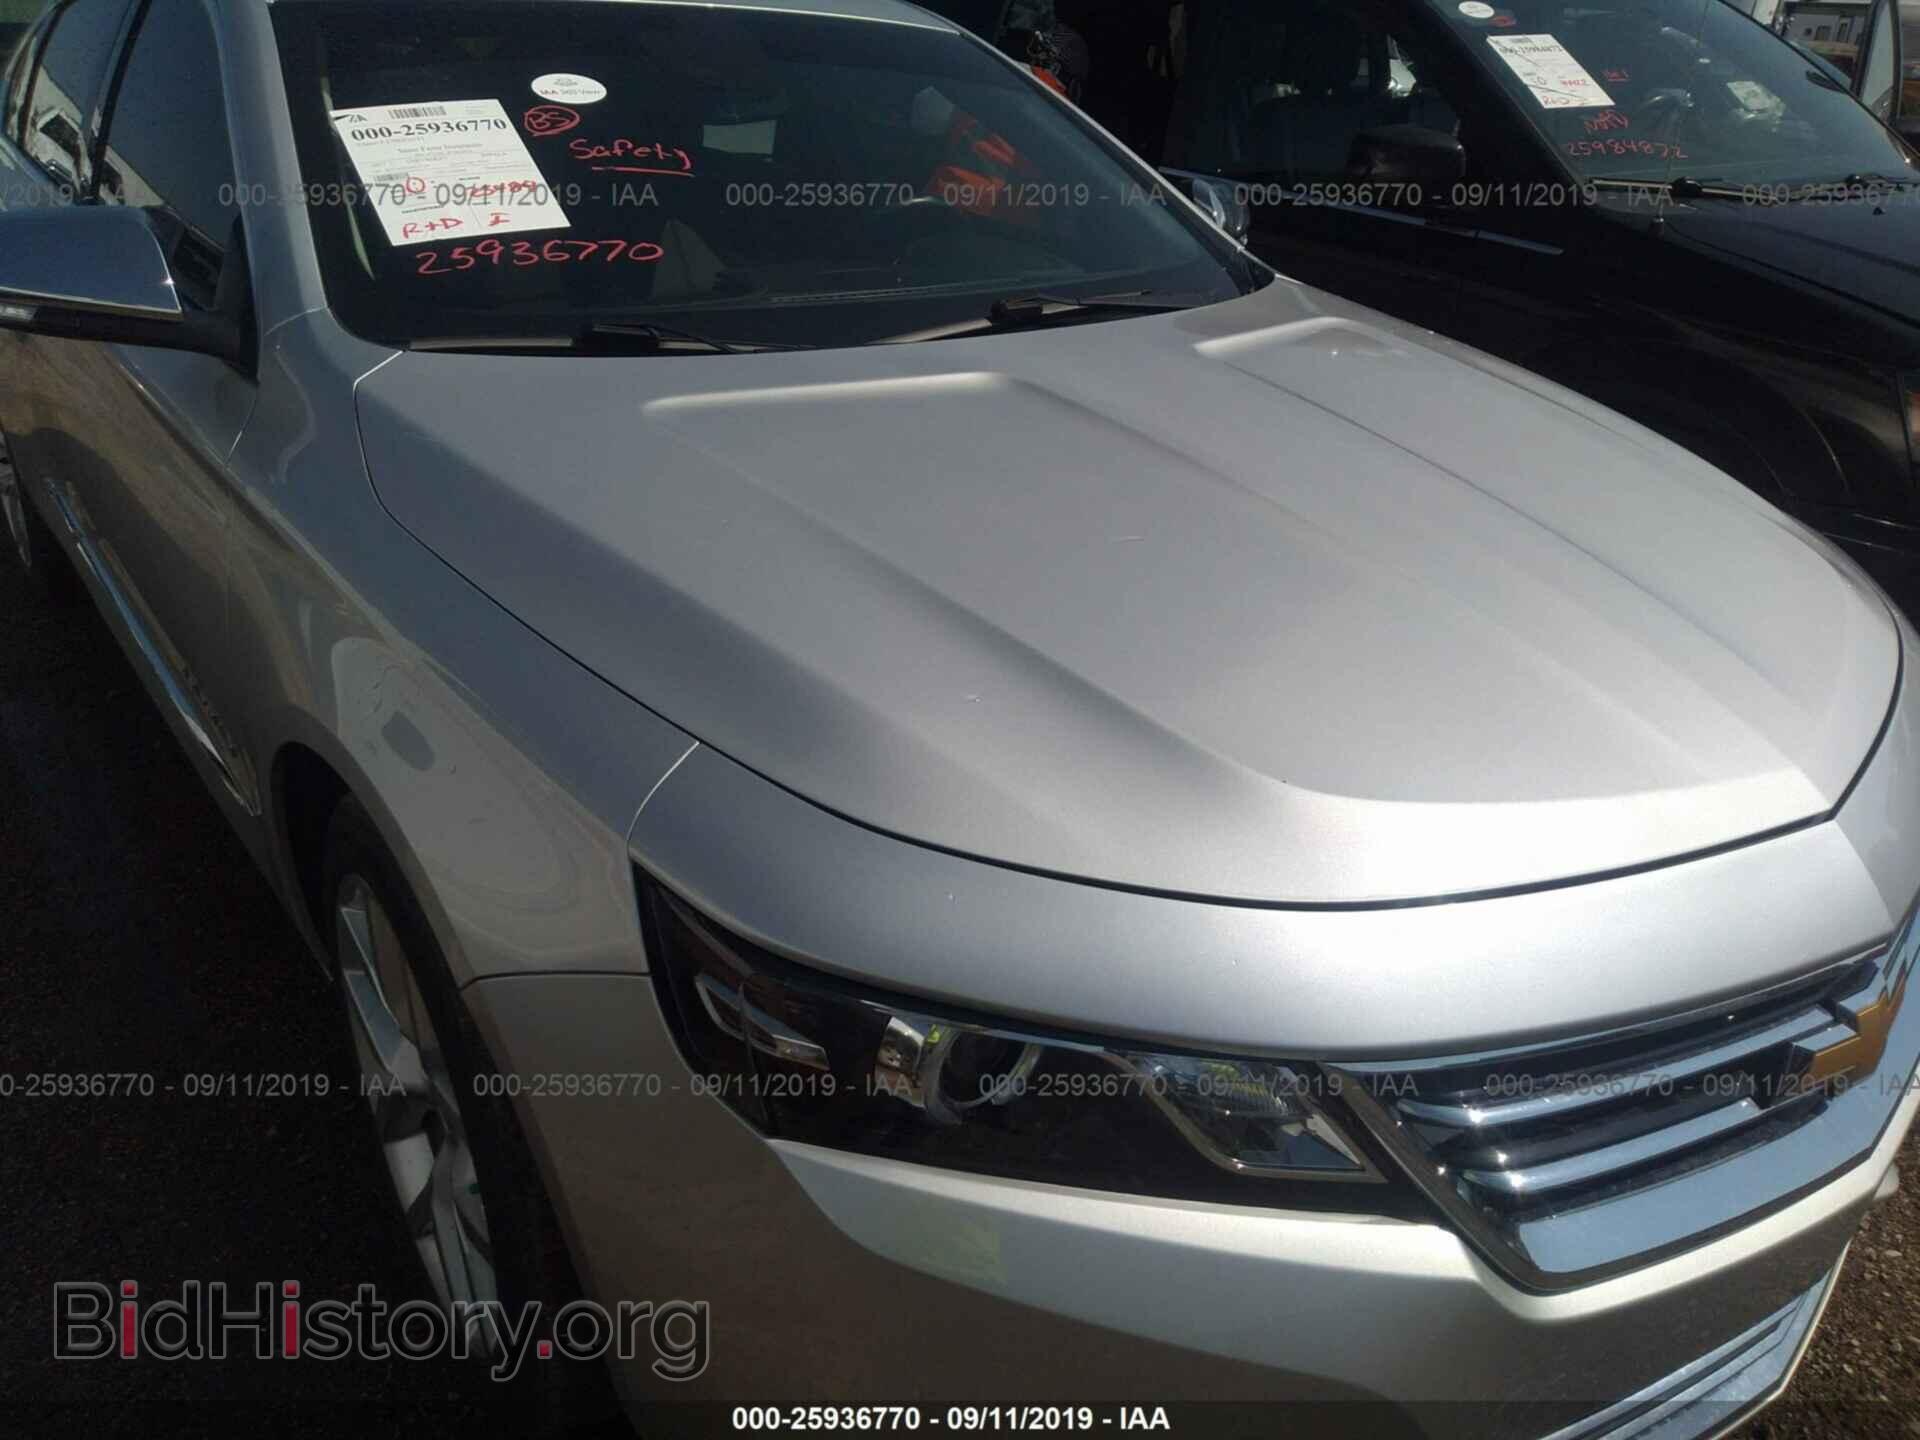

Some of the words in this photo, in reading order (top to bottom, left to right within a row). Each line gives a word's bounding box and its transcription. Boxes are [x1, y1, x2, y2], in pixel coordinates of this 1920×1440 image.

[351, 118, 506, 141] 000-25936770
[569, 138, 692, 170] Safety
[416, 239, 664, 274] 25936770
